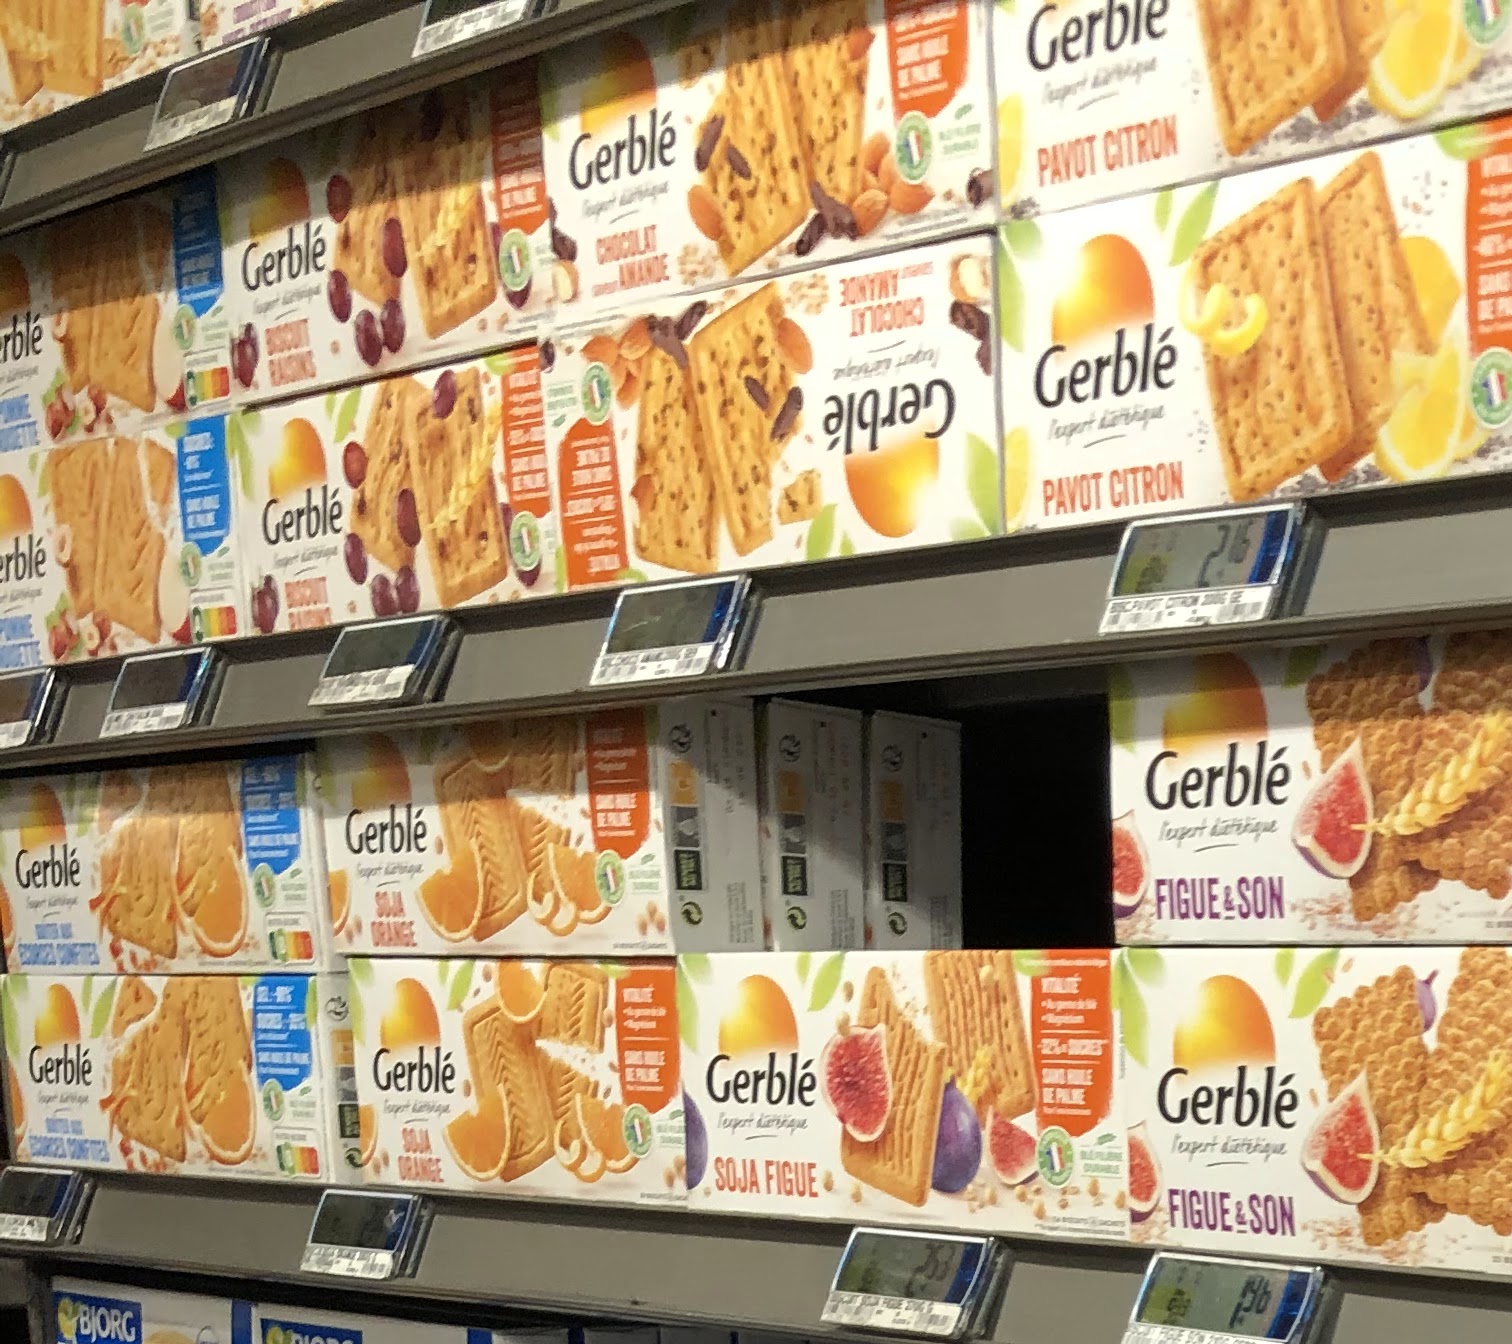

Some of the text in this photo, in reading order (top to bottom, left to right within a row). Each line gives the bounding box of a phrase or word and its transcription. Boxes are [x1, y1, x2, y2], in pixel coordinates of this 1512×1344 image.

[569, 109, 677, 190] Gerblé
[1037, 114, 1178, 187] PAVOT CITRON
[242, 222, 327, 292] Gerblé
[1035, 325, 1178, 407] Gerblé
[823, 378, 956, 454] Gerblé
[262, 483, 343, 546] Gerblé
[1043, 462, 1184, 516] PAVOT CITRON
[1146, 743, 1293, 811] Gerblé
[345, 803, 428, 855] Gerblé
[29, 1041, 94, 1087] Gerblé
[373, 1043, 457, 1094] Gerblé
[707, 1053, 817, 1107] Gerblé
[1157, 1067, 1300, 1129] Gerblé
[714, 1157, 818, 1200] SOJA FIGUE
[79, 1302, 139, 1344] BJORG
